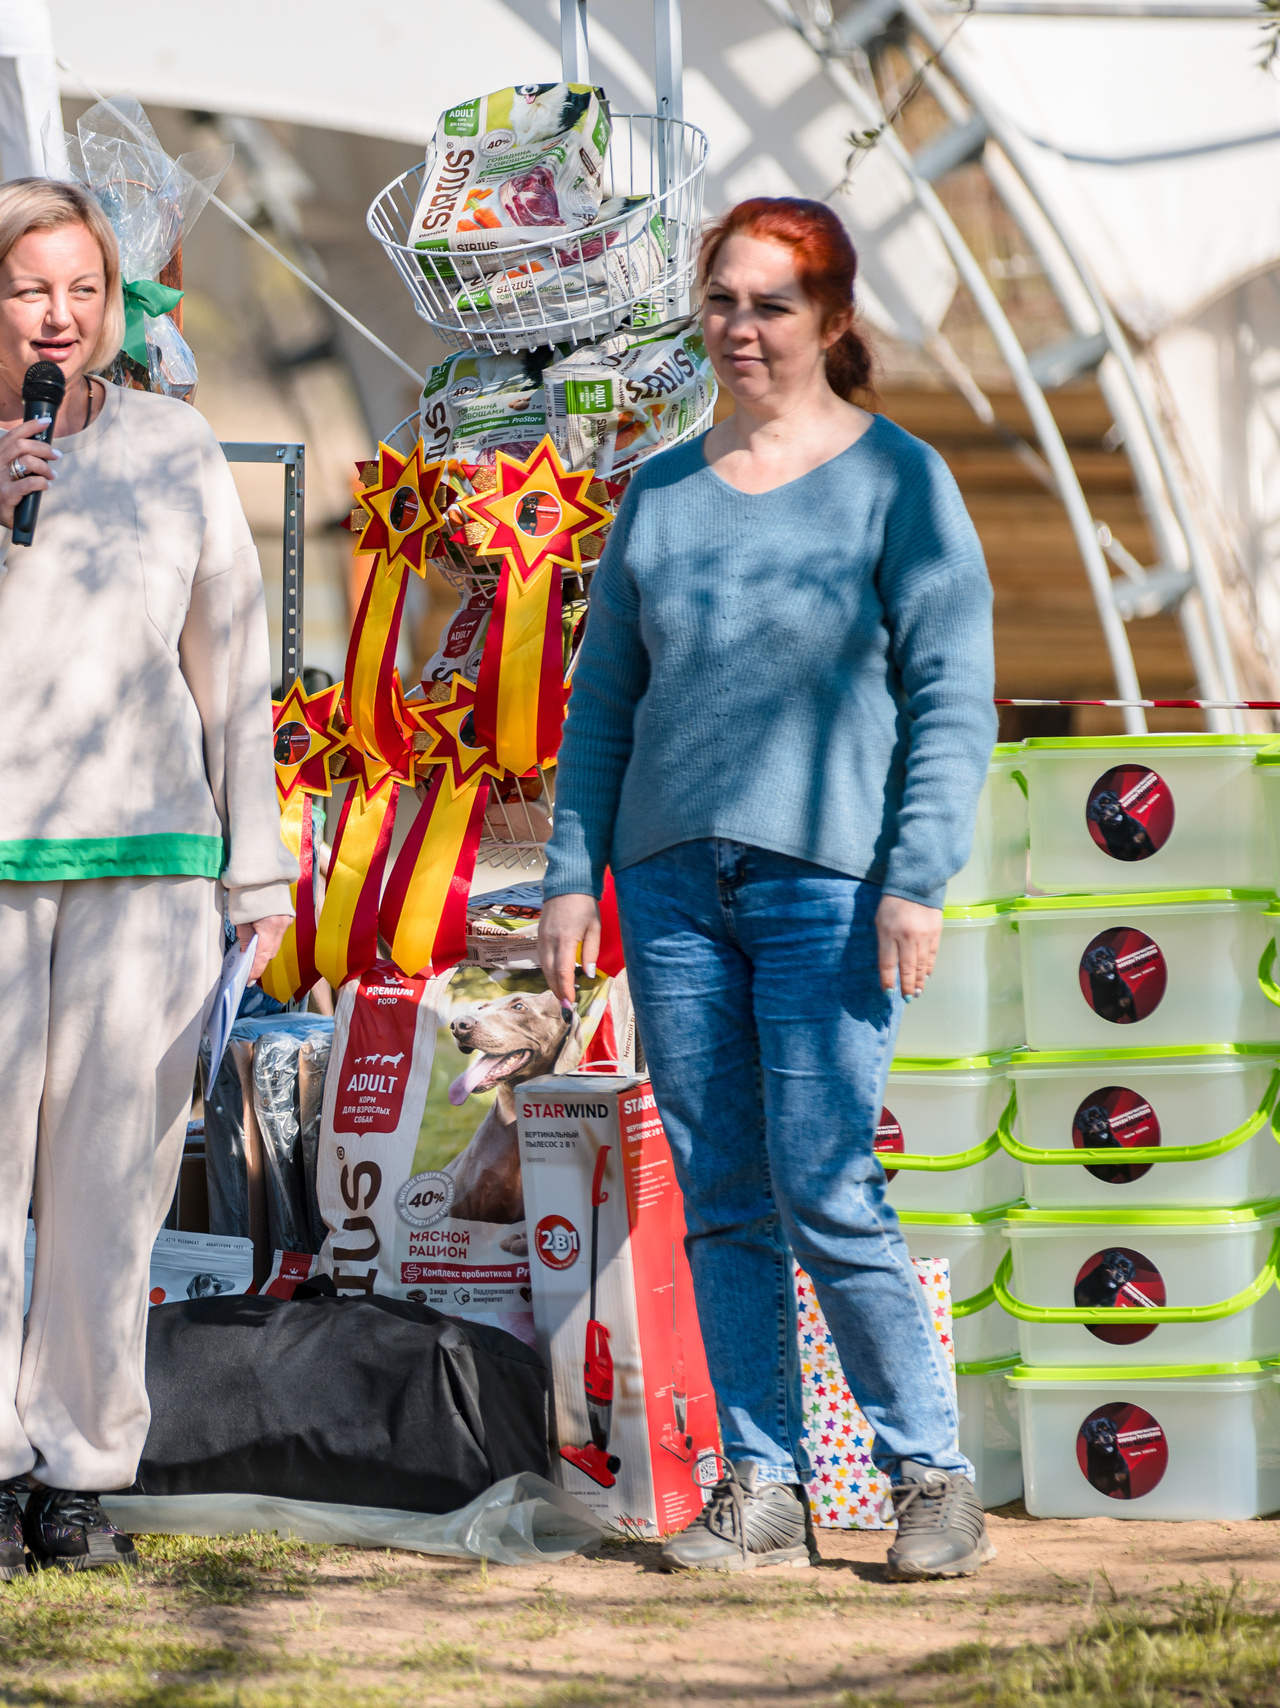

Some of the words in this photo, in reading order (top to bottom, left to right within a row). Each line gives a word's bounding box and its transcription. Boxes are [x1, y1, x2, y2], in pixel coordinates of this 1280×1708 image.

[449, 108, 474, 118] ADULT
[487, 138, 510, 150] 40%
[422, 150, 475, 230] SIRIUS
[457, 242, 497, 252] SIRIUS
[626, 348, 695, 404] SIRIUS
[454, 386, 478, 398] 40%
[594, 384, 606, 408] ADULT
[450, 630, 472, 642] ADULT
[476, 926, 508, 936] SIRIUS
[366, 986, 414, 997] PREMIUM
[378, 998, 398, 1006] FOOD
[346, 1073, 398, 1094] ADULT
[358, 1096, 376, 1104] КОРМ
[624, 1094, 657, 1114] STAR
[342, 1106, 356, 1114] ДЛЯ
[356, 1106, 390, 1116] ВЗРОСЛЫХ
[523, 1104, 608, 1118] STARWIND
[354, 1116, 374, 1124] СОБАК
[525, 1130, 579, 1138] ВЕРТИКАЛЬНЫЙ
[399, 1179, 418, 1204] ВЫСОКОЕ
[416, 1172, 452, 1185] СОДЕРЖАНИЕ
[408, 1190, 445, 1208] 40%
[410, 1230, 470, 1246] МЯСНОЙ
[409, 1245, 467, 1260] РАЦИОН
[422, 1268, 460, 1279] Комплекс
[461, 1270, 512, 1280] пробиотиков
[434, 1288, 448, 1297] вида
[473, 1288, 514, 1296] Поддерживает
